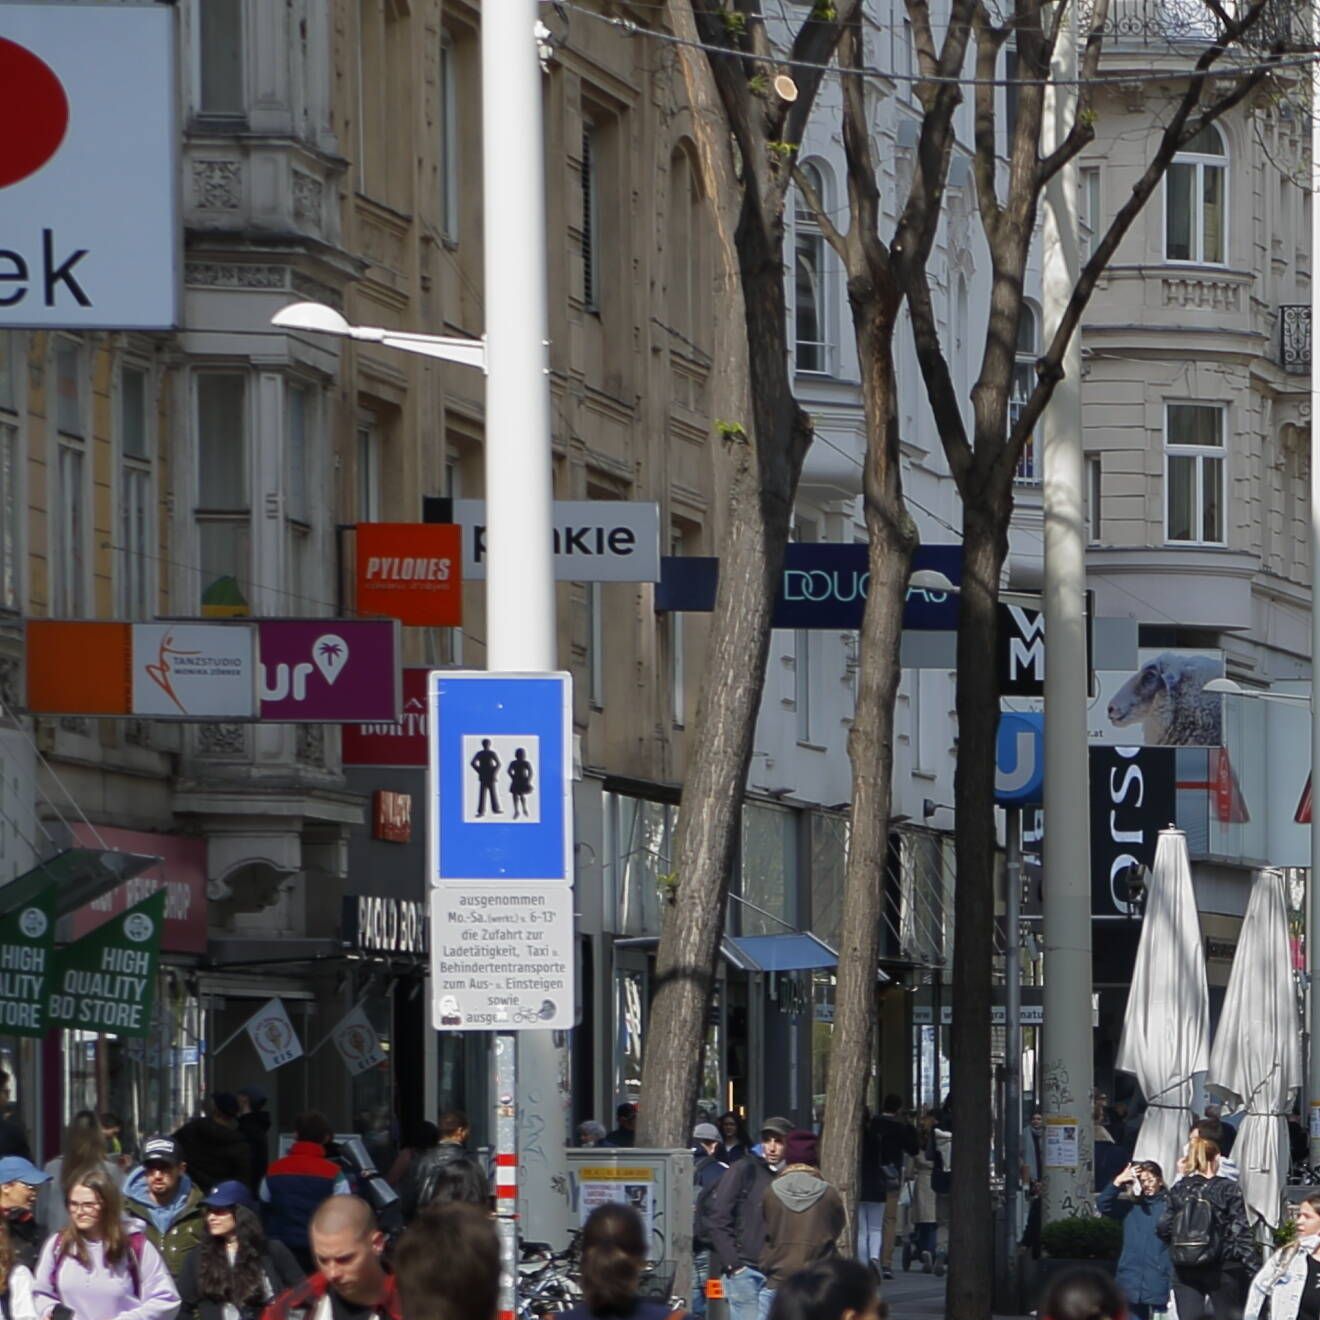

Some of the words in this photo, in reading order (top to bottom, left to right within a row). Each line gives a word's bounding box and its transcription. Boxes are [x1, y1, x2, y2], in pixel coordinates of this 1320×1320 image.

[366, 557, 451, 581] PYLONES
[173, 656, 242, 668] TANZSTUDIO
[459, 895, 545, 908] ausgenommen
[461, 929, 478, 940] die
[481, 928, 523, 941] Zufahrt
[525, 930, 544, 940] zur
[1, 944, 45, 972] HIGH
[443, 945, 520, 959] Ladetätigkeit,
[527, 945, 549, 957] Taxi
[101, 946, 149, 975] HIGH
[440, 961, 566, 975] Behindertentransporte
[63, 969, 148, 1002] QUALITY
[443, 980, 465, 990] zum
[469, 978, 494, 990] Aus-
[506, 978, 563, 992] Einsteigen
[488, 994, 520, 1006] sowie
[79, 998, 144, 1029] STORE
